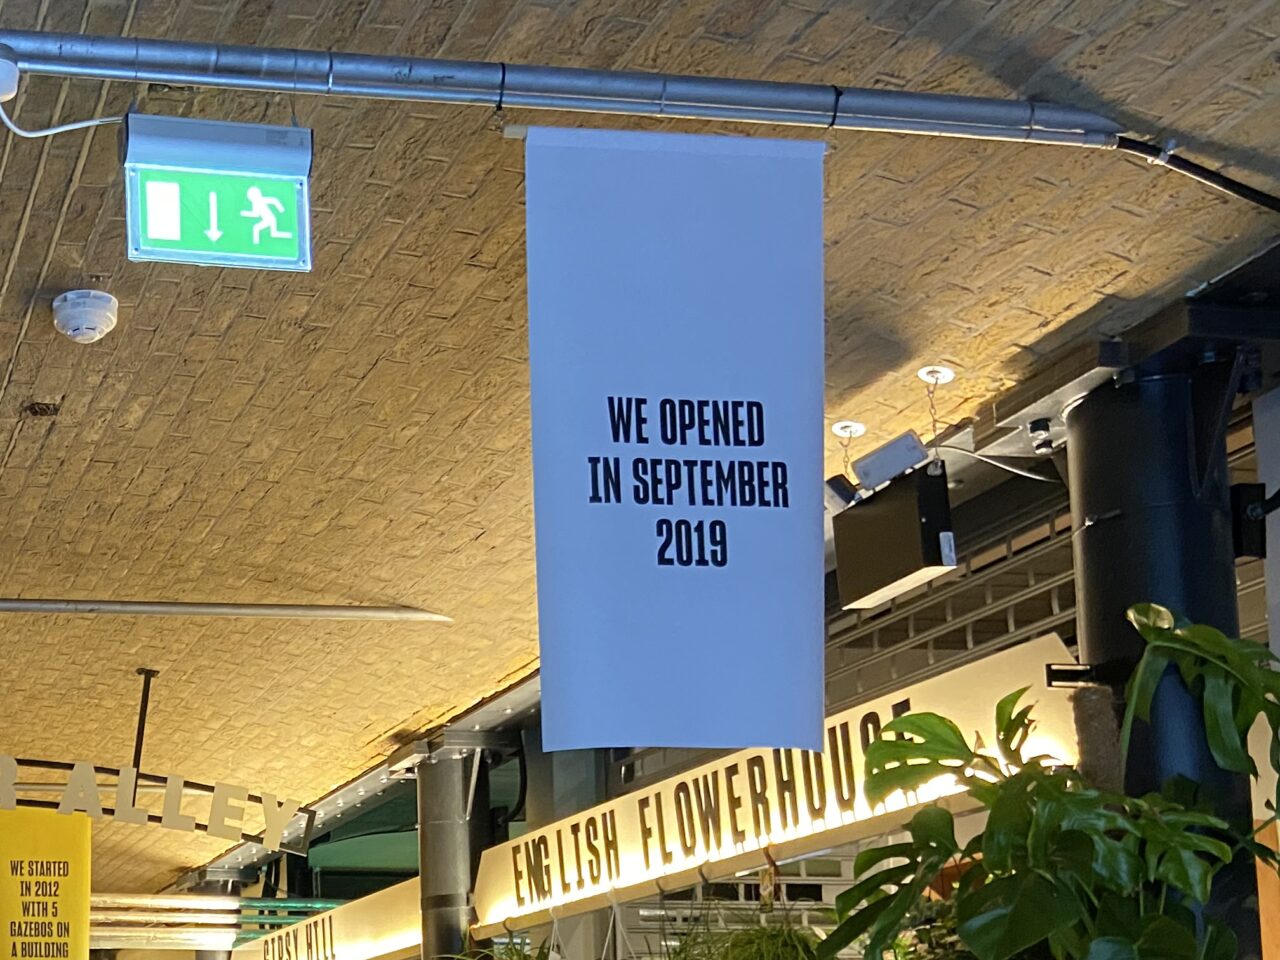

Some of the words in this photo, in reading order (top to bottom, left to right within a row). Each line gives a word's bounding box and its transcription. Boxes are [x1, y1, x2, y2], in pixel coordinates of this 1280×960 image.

[607, 396, 649, 444] WE
[659, 398, 765, 447] OPENED
[587, 456, 621, 504] IN
[632, 457, 789, 508] SEPTEMBER
[656, 518, 728, 568] 2019
[56, 761, 302, 852] ALLEY
[10, 860, 24, 877] WE
[27, 860, 69, 878] STARTED
[512, 809, 620, 908] ENGLISH
[20, 880, 31, 897] IN
[34, 880, 60, 897] 2012
[21, 901, 48, 918] WITH
[51, 901, 58, 918] 5
[9, 921, 53, 938] GAZEBOS
[56, 922, 70, 938] ON
[11, 942, 18, 958] A
[21, 942, 69, 959] BUILDING
